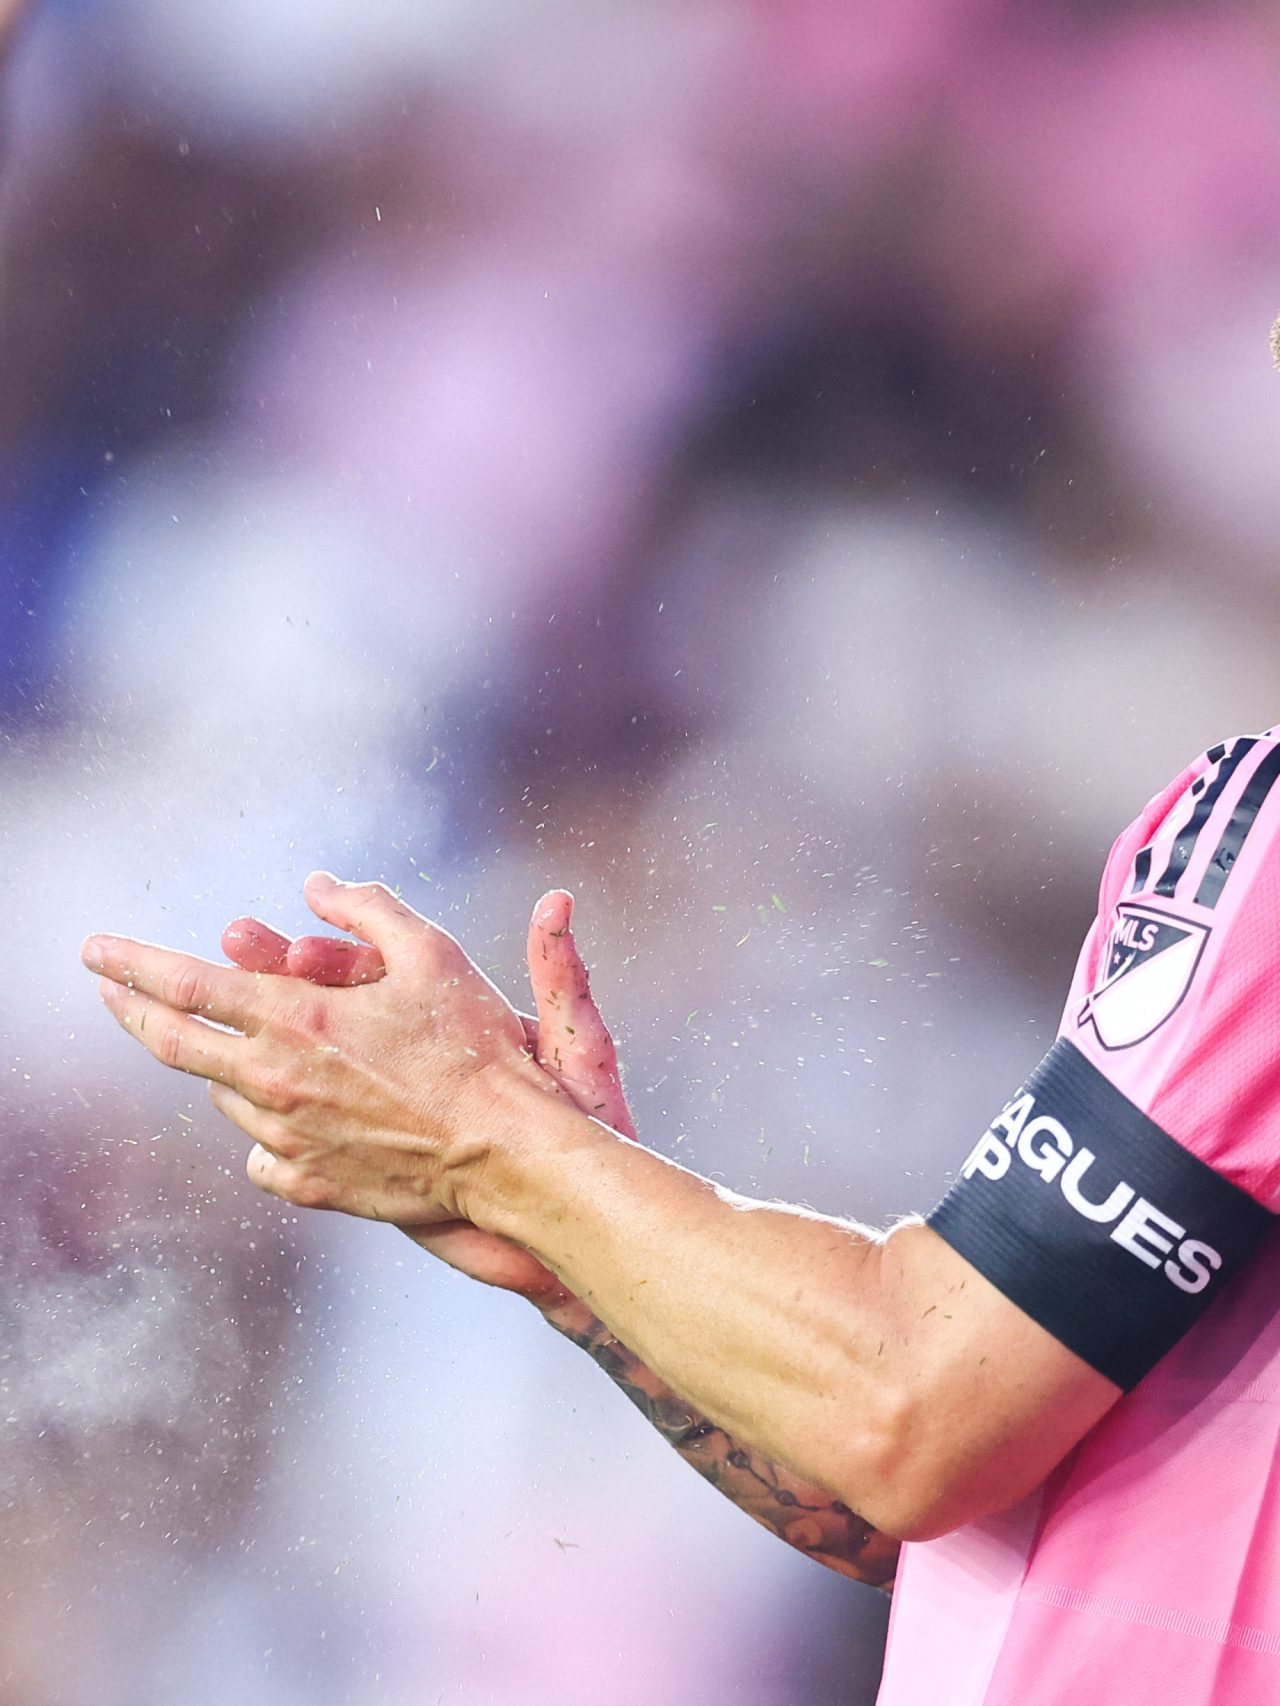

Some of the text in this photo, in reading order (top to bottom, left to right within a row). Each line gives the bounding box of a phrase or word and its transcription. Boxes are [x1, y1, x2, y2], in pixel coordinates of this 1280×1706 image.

[1113, 917, 1159, 952] MLS
[960, 1128, 1012, 1181] P
[990, 1087, 1223, 1295] AGUES
